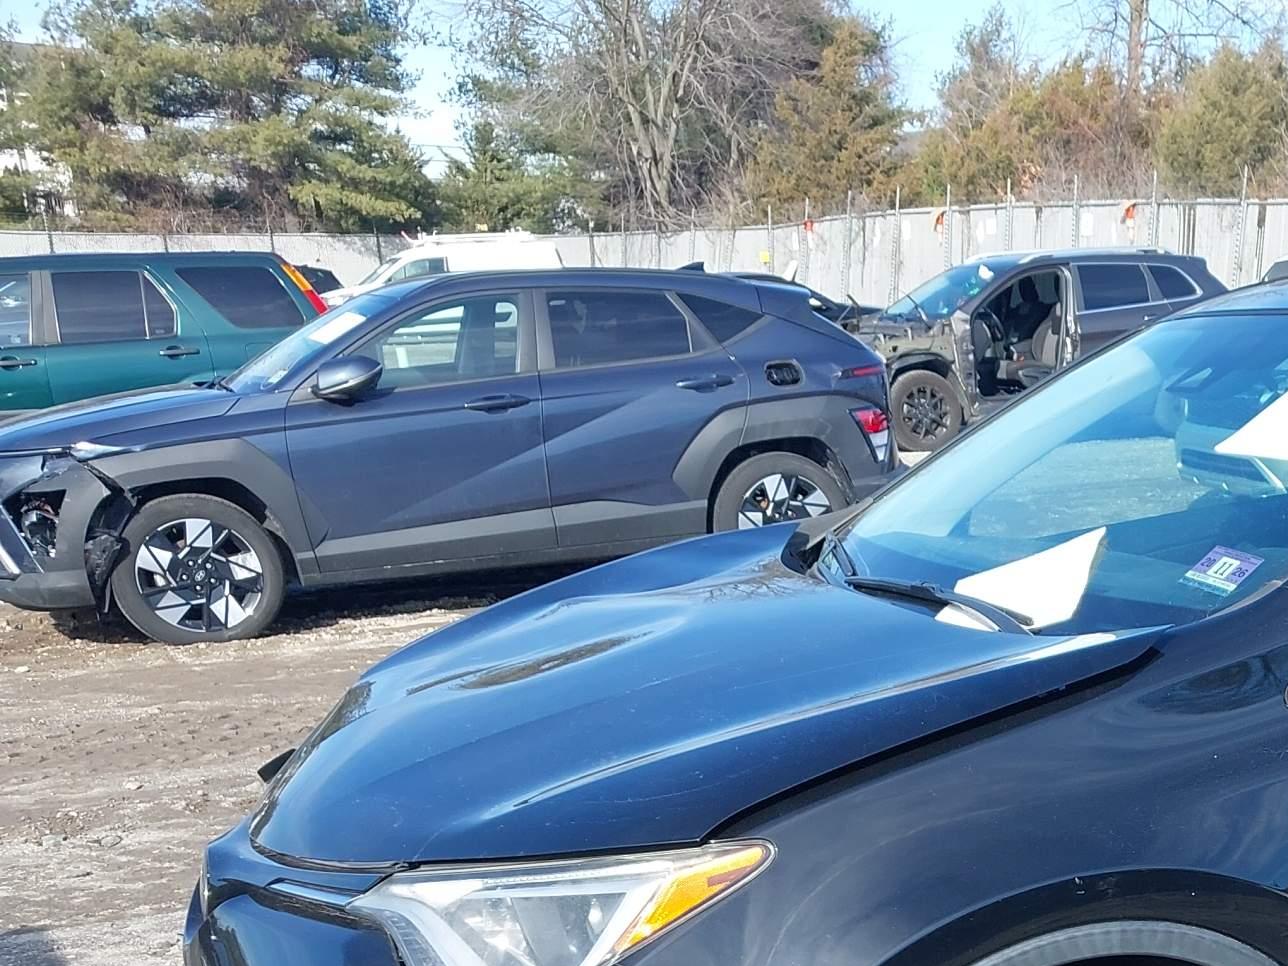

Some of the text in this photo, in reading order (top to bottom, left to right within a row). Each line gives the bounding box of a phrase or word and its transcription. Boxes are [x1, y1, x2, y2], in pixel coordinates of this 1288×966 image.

[1200, 557, 1249, 578] 20 11 26
